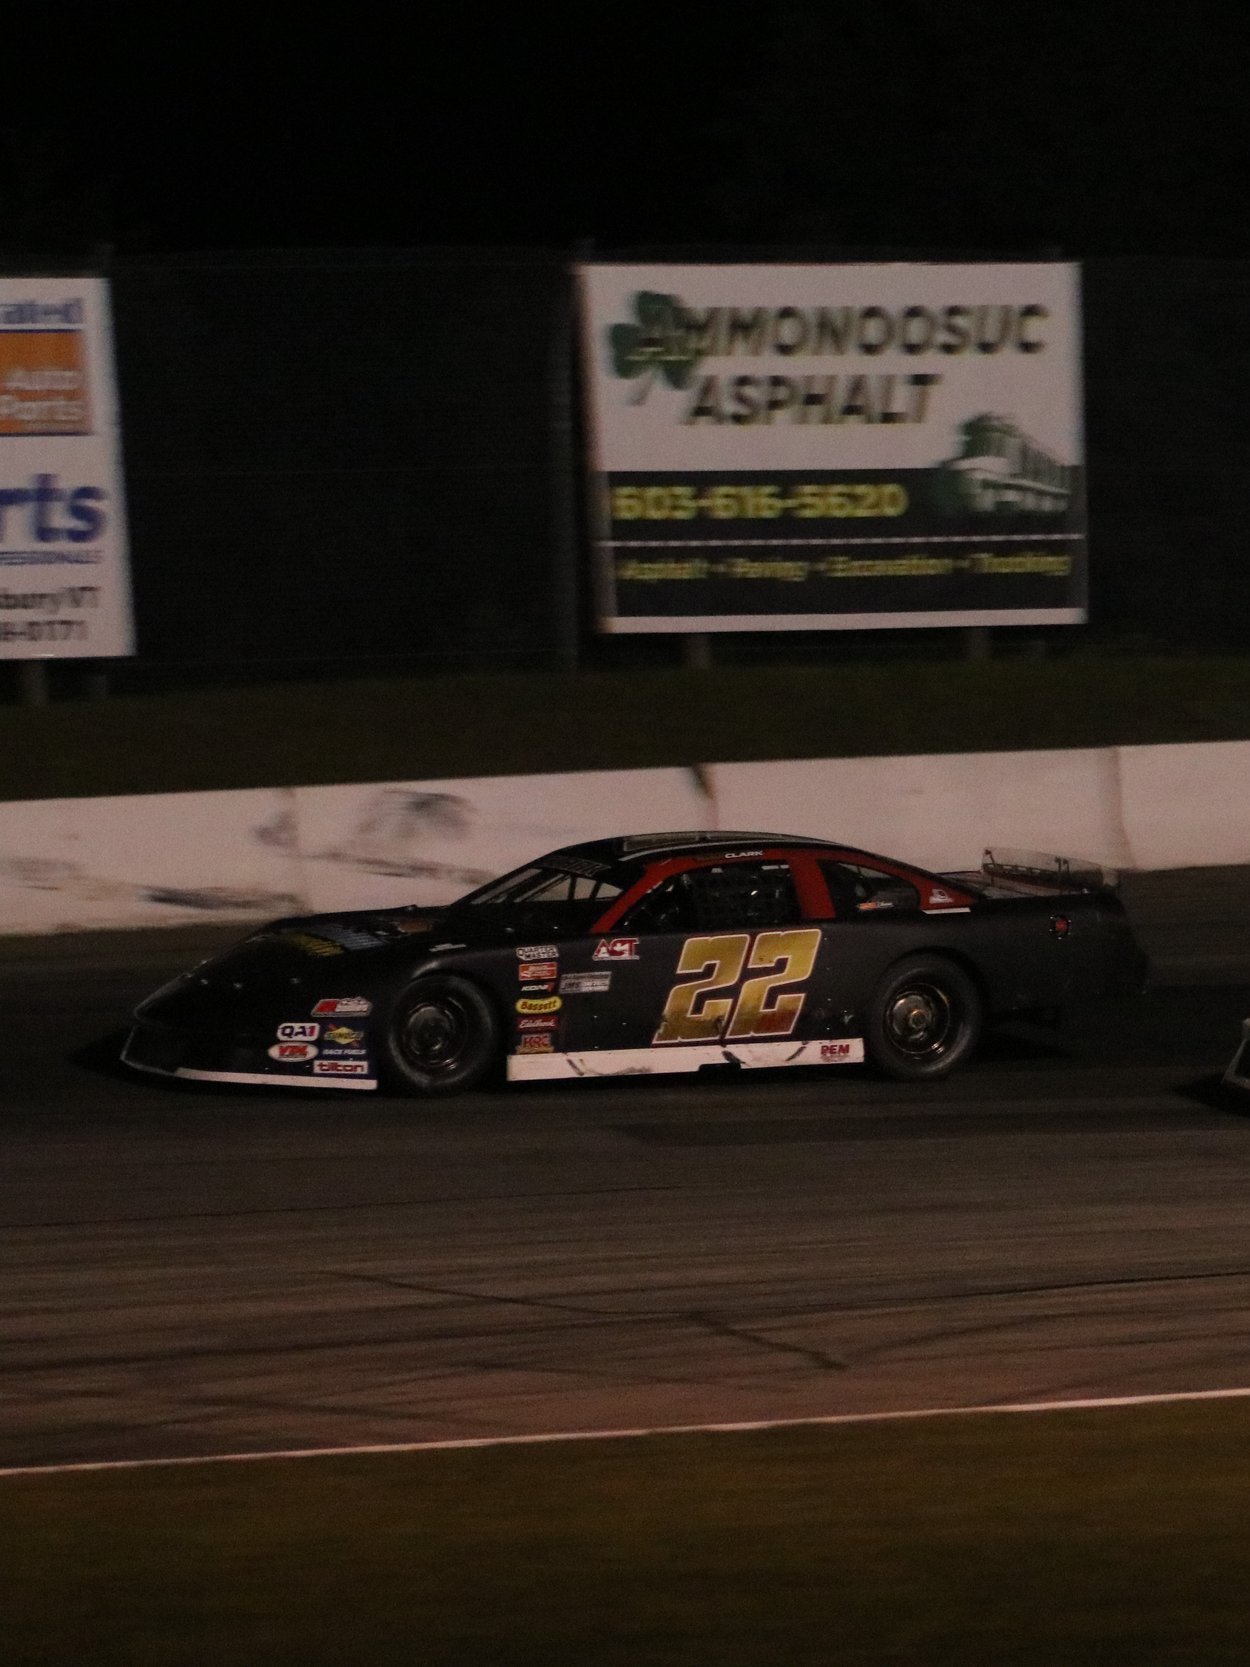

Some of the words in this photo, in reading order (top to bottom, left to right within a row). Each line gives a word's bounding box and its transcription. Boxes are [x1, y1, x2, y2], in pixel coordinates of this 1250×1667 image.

[682, 373, 940, 425] ASPHALT
[724, 850, 764, 860] CLARK
[651, 928, 822, 1045] 22
[520, 999, 557, 1011] Bassett
[281, 1025, 316, 1038] QA1
